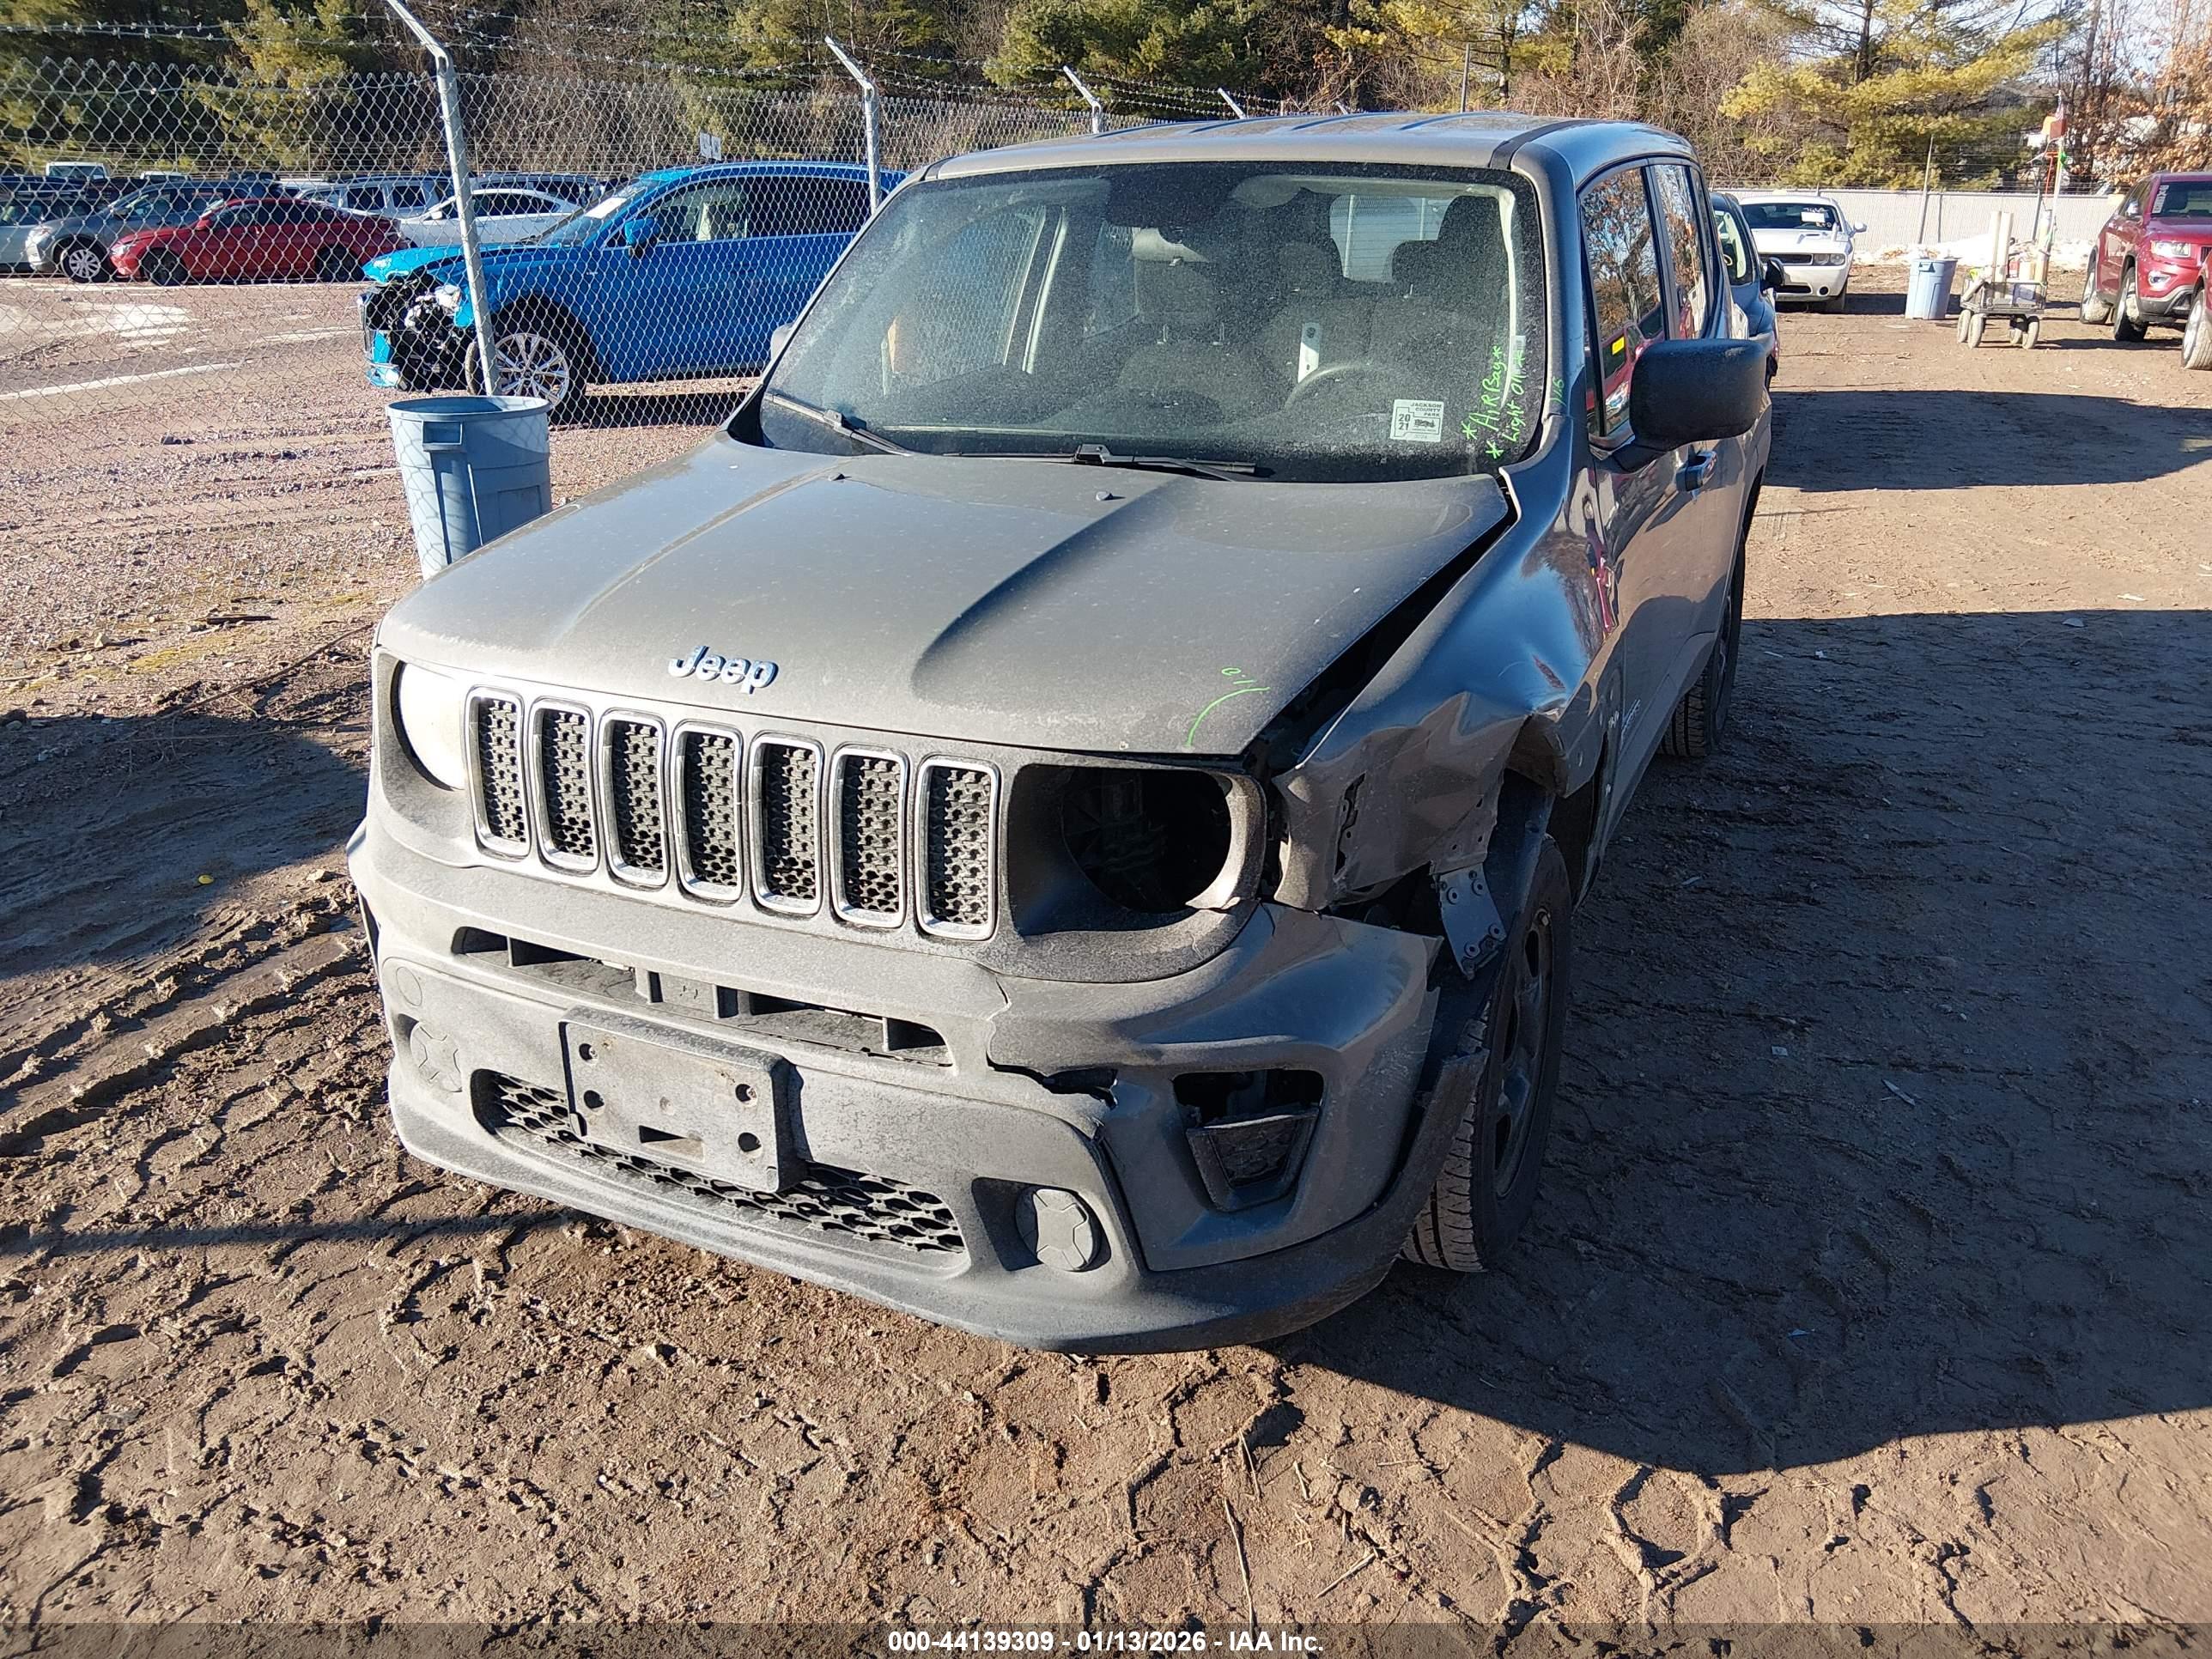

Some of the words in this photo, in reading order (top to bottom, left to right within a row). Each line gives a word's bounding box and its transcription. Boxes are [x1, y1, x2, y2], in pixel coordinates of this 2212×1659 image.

[1398, 414, 1411, 422] 20
[1398, 422, 1409, 431] 21
[667, 645, 779, 696] Jeep
